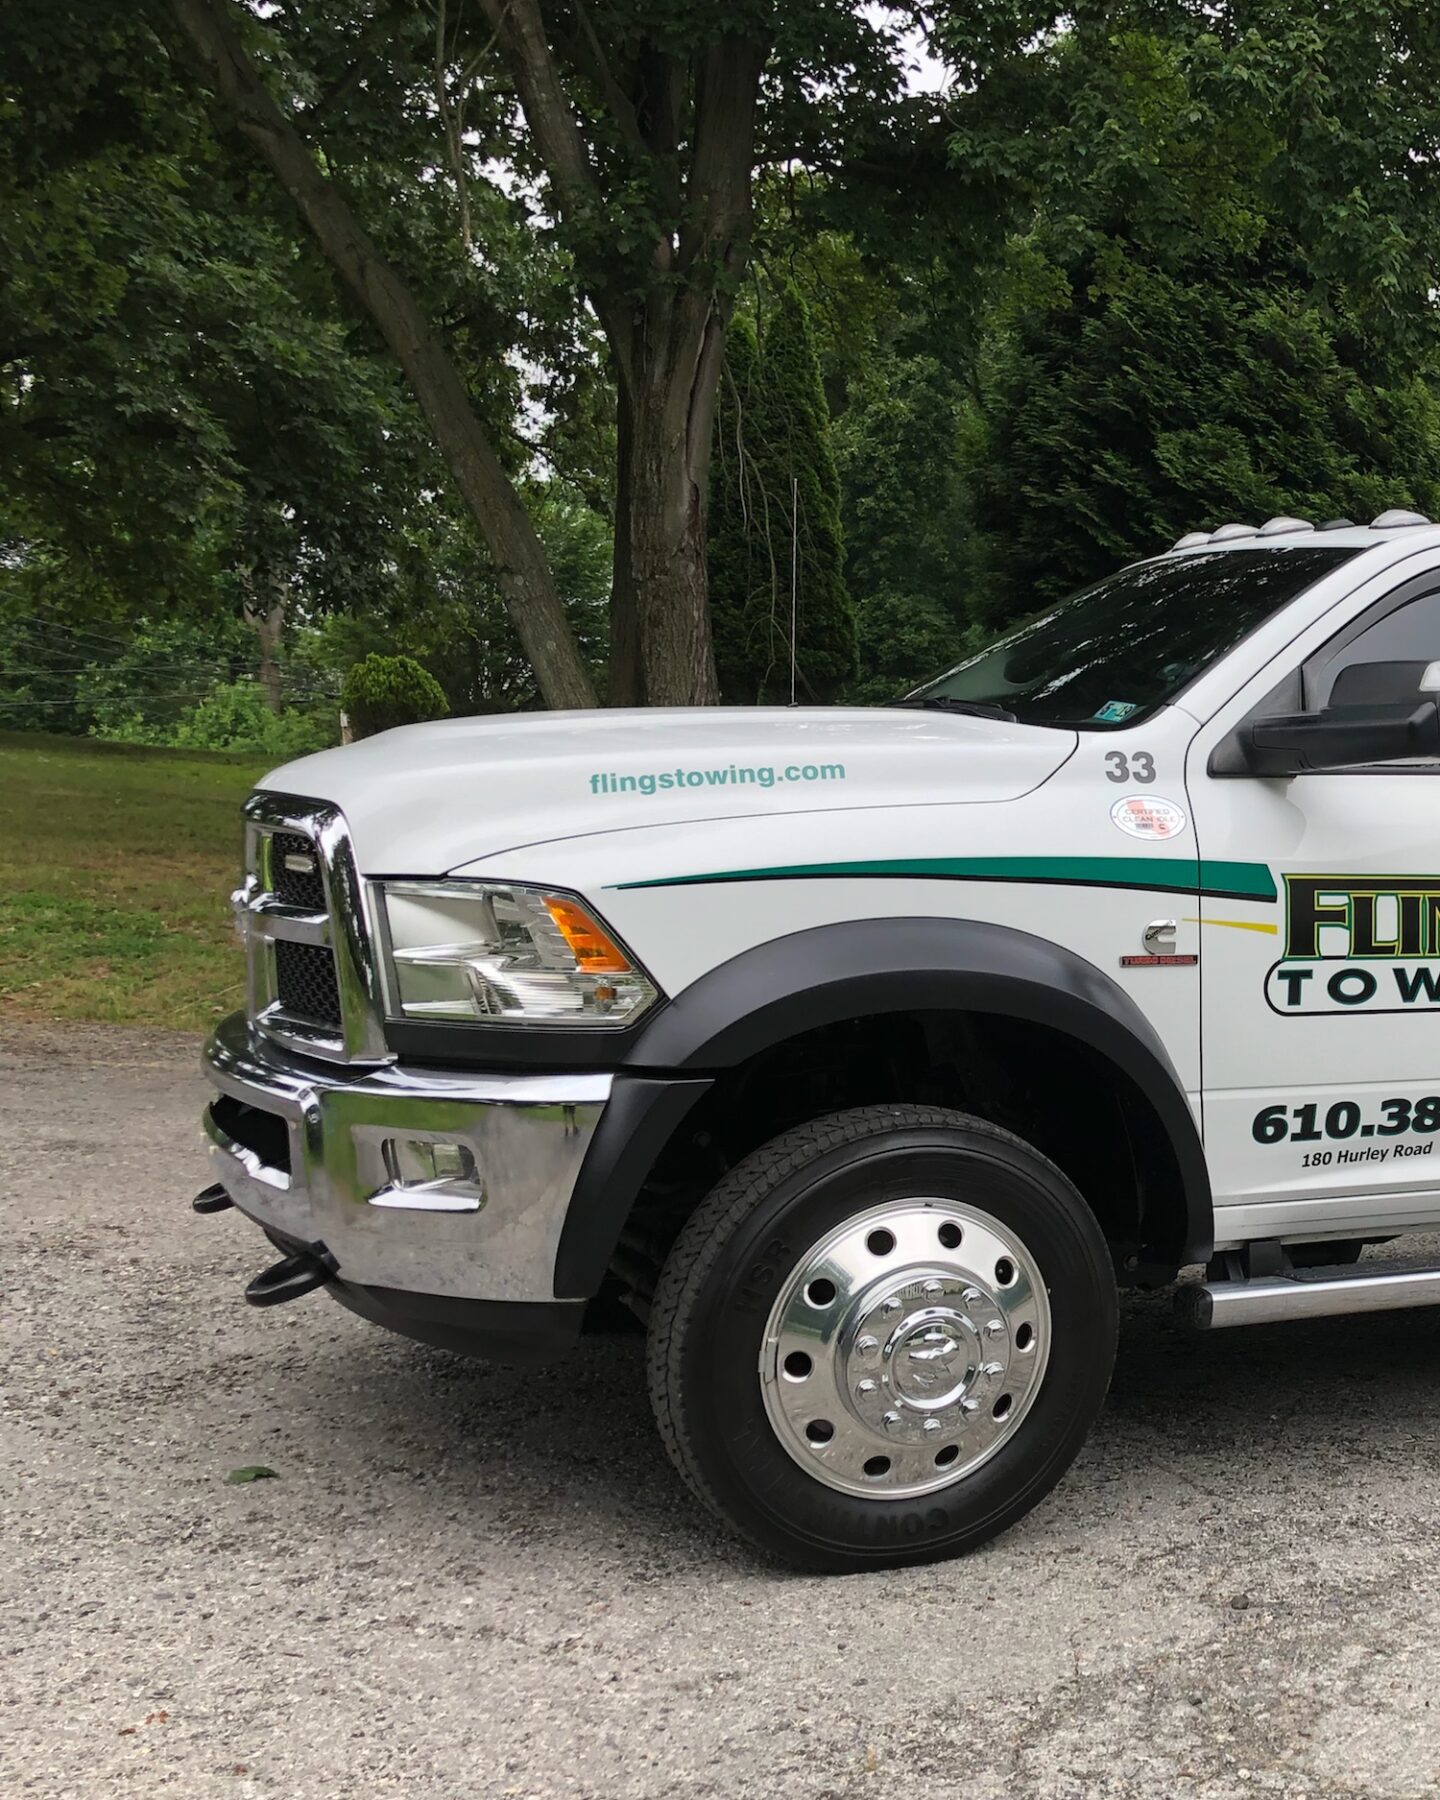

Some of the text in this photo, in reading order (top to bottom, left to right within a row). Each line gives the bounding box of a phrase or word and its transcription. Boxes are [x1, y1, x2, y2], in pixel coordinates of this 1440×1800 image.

[589, 763, 846, 795] flingstowing.com
[1104, 750, 1157, 784] 33
[1301, 1151, 1332, 1168] 180
[1336, 1146, 1389, 1165] Hurley
[1392, 1141, 1433, 1158] Road
